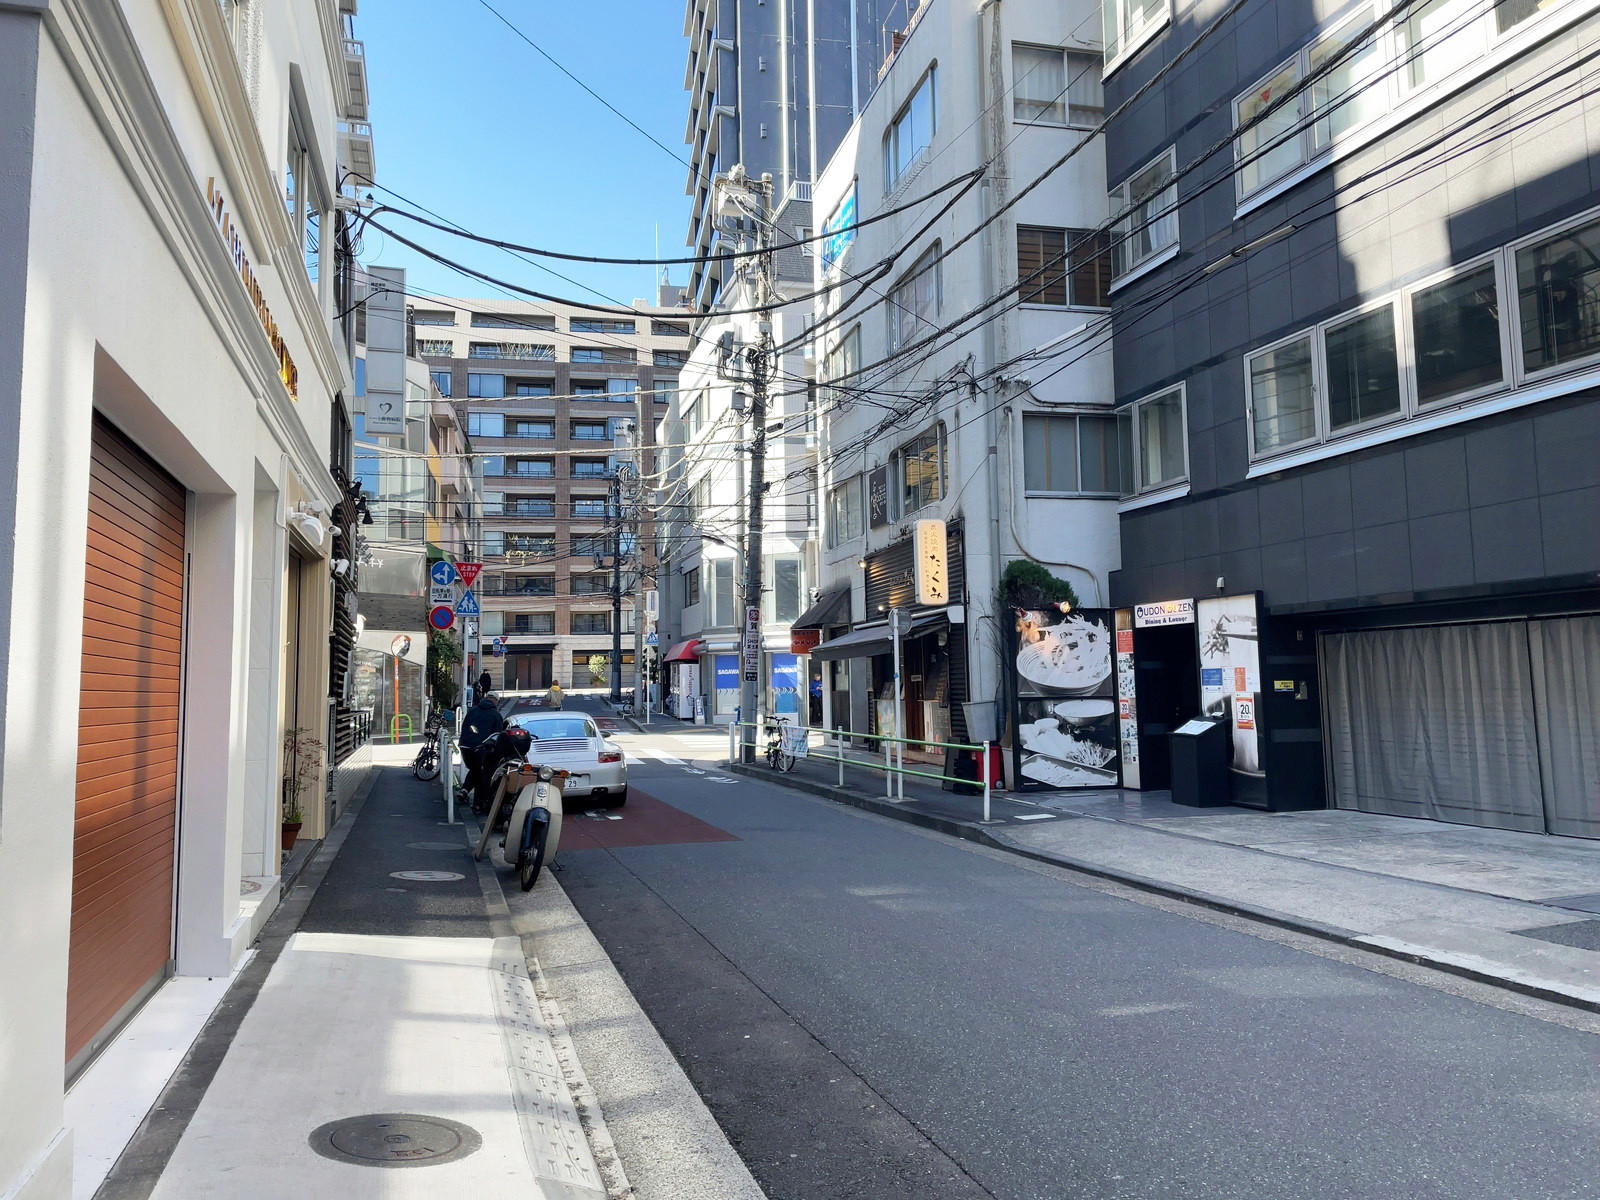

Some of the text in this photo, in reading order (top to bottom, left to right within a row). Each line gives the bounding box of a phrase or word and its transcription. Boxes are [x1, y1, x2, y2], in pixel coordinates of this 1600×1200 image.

[929, 554, 943, 599] たくみ
[1143, 604, 1166, 616] UDON
